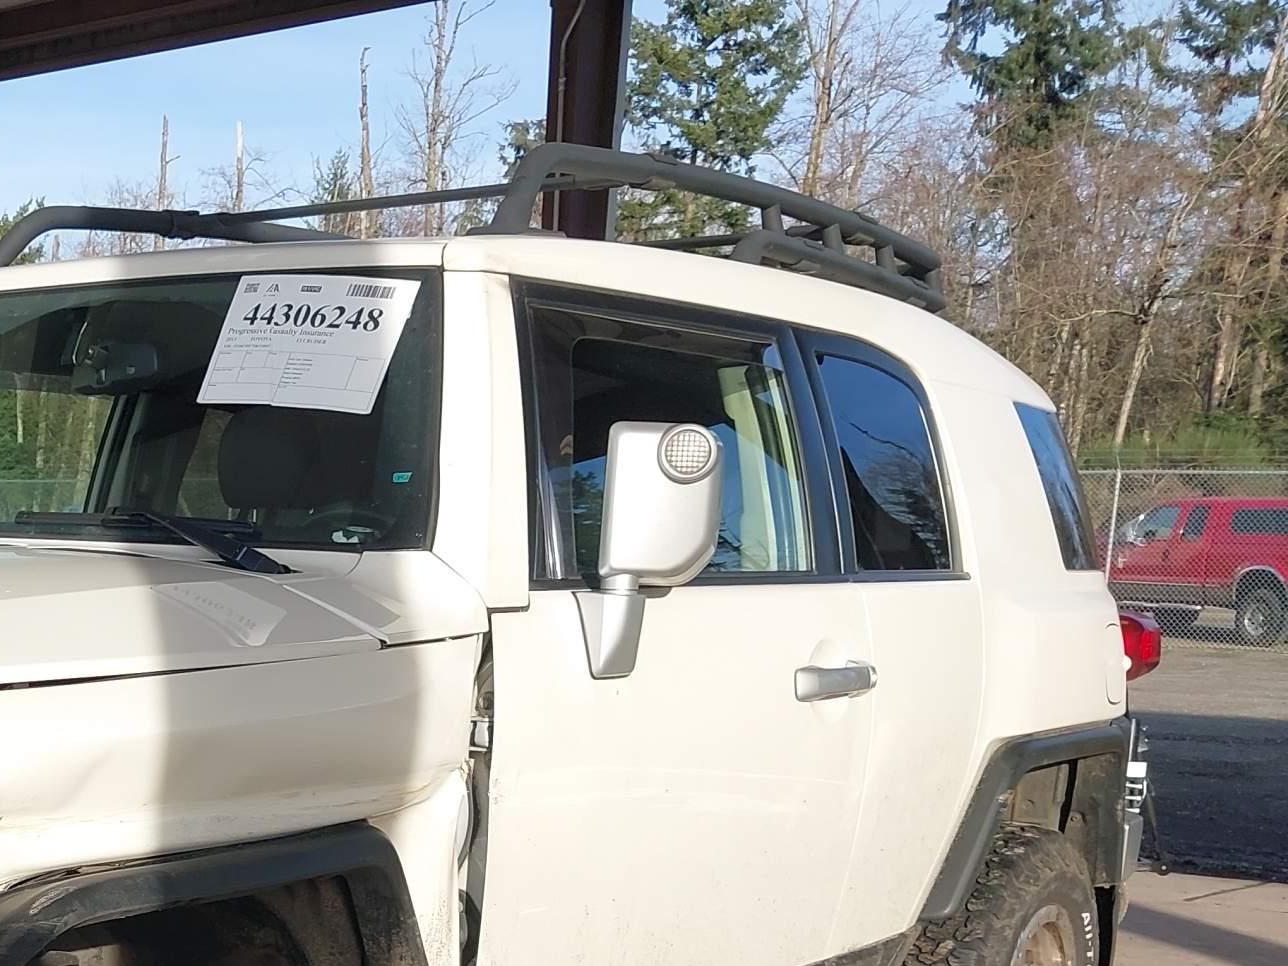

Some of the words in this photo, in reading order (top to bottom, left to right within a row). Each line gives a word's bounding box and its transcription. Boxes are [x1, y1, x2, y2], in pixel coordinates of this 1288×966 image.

[243, 303, 383, 332] 44306248
[227, 327, 269, 336] Progressive
[270, 328, 296, 337] Casualty
[299, 330, 334, 338] Insurance
